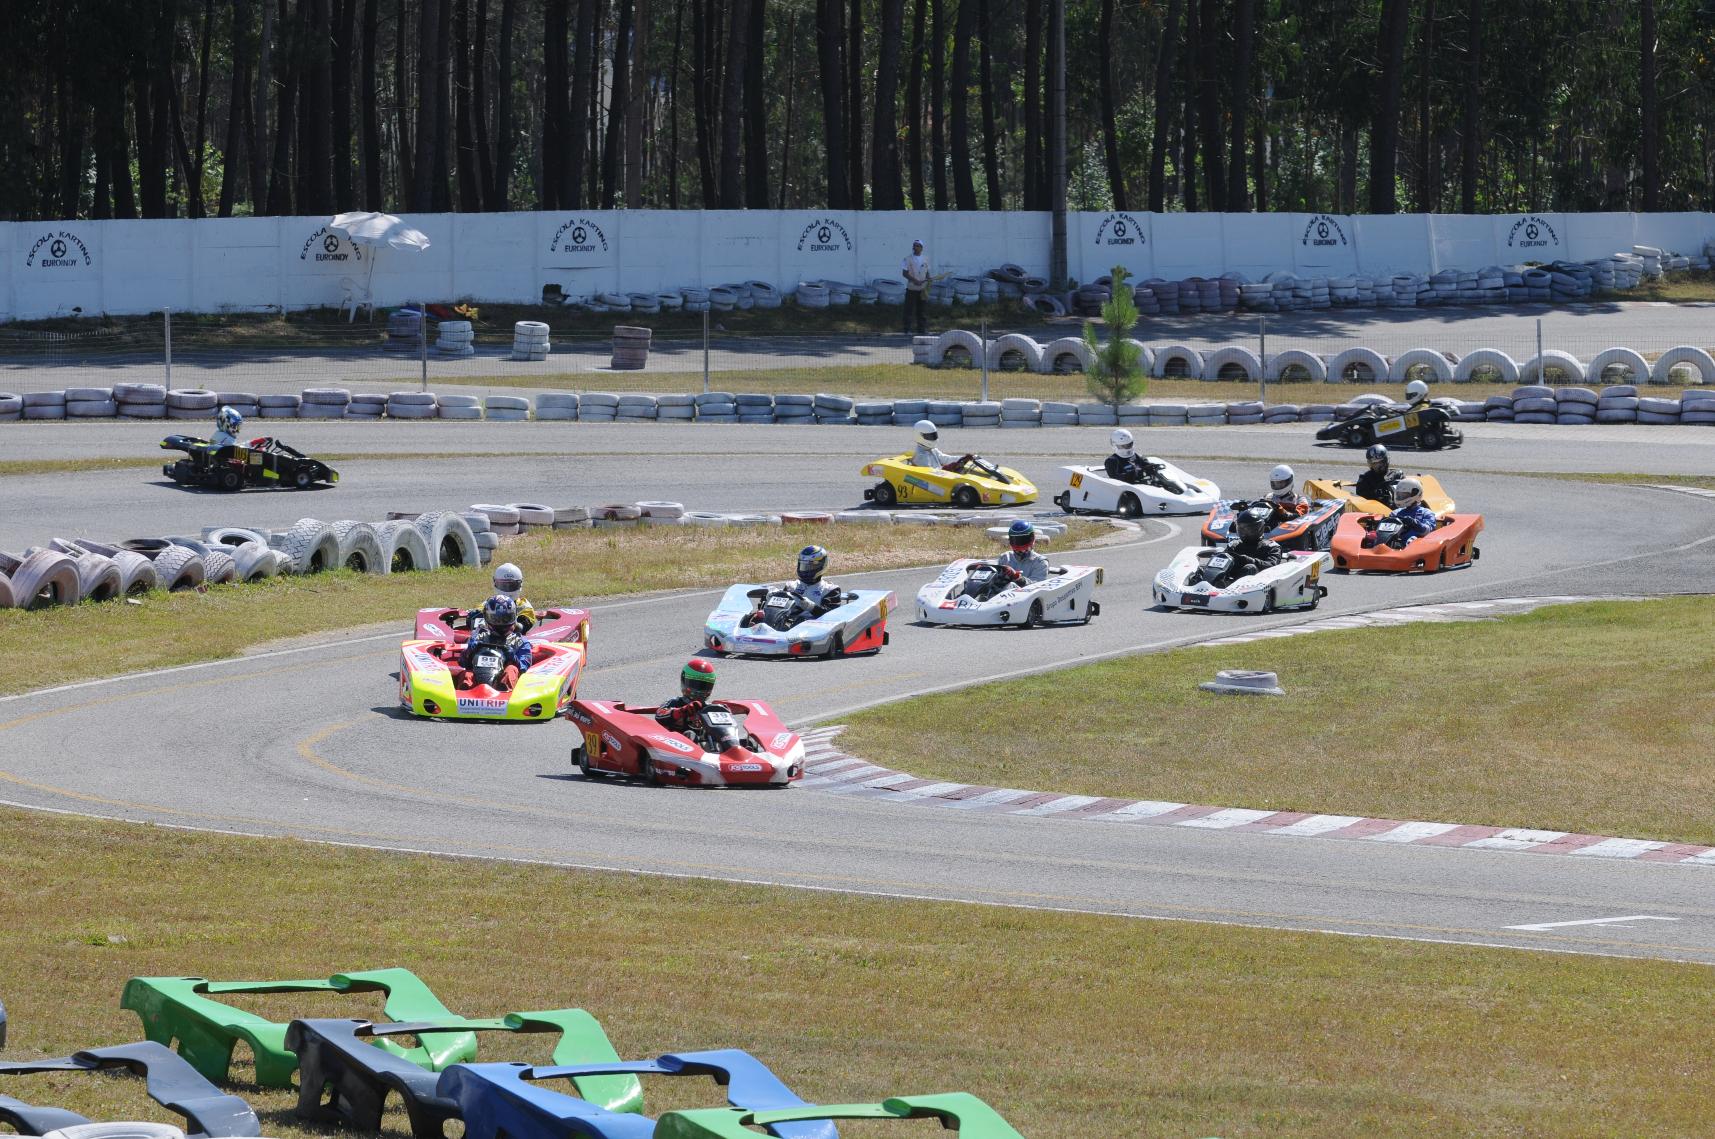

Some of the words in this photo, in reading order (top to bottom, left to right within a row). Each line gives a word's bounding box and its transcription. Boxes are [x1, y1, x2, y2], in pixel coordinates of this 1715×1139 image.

[301, 227, 327, 260] ESCOLA
[551, 219, 576, 252] ESCOLA
[580, 218, 608, 252] KARTING
[27, 232, 54, 267] ESCOLA
[59, 231, 91, 266] KARTING
[315, 253, 349, 261] EUROINDY
[897, 485, 908, 499] 93
[459, 698, 506, 708] UNITRIP
[587, 734, 597, 755] 39
